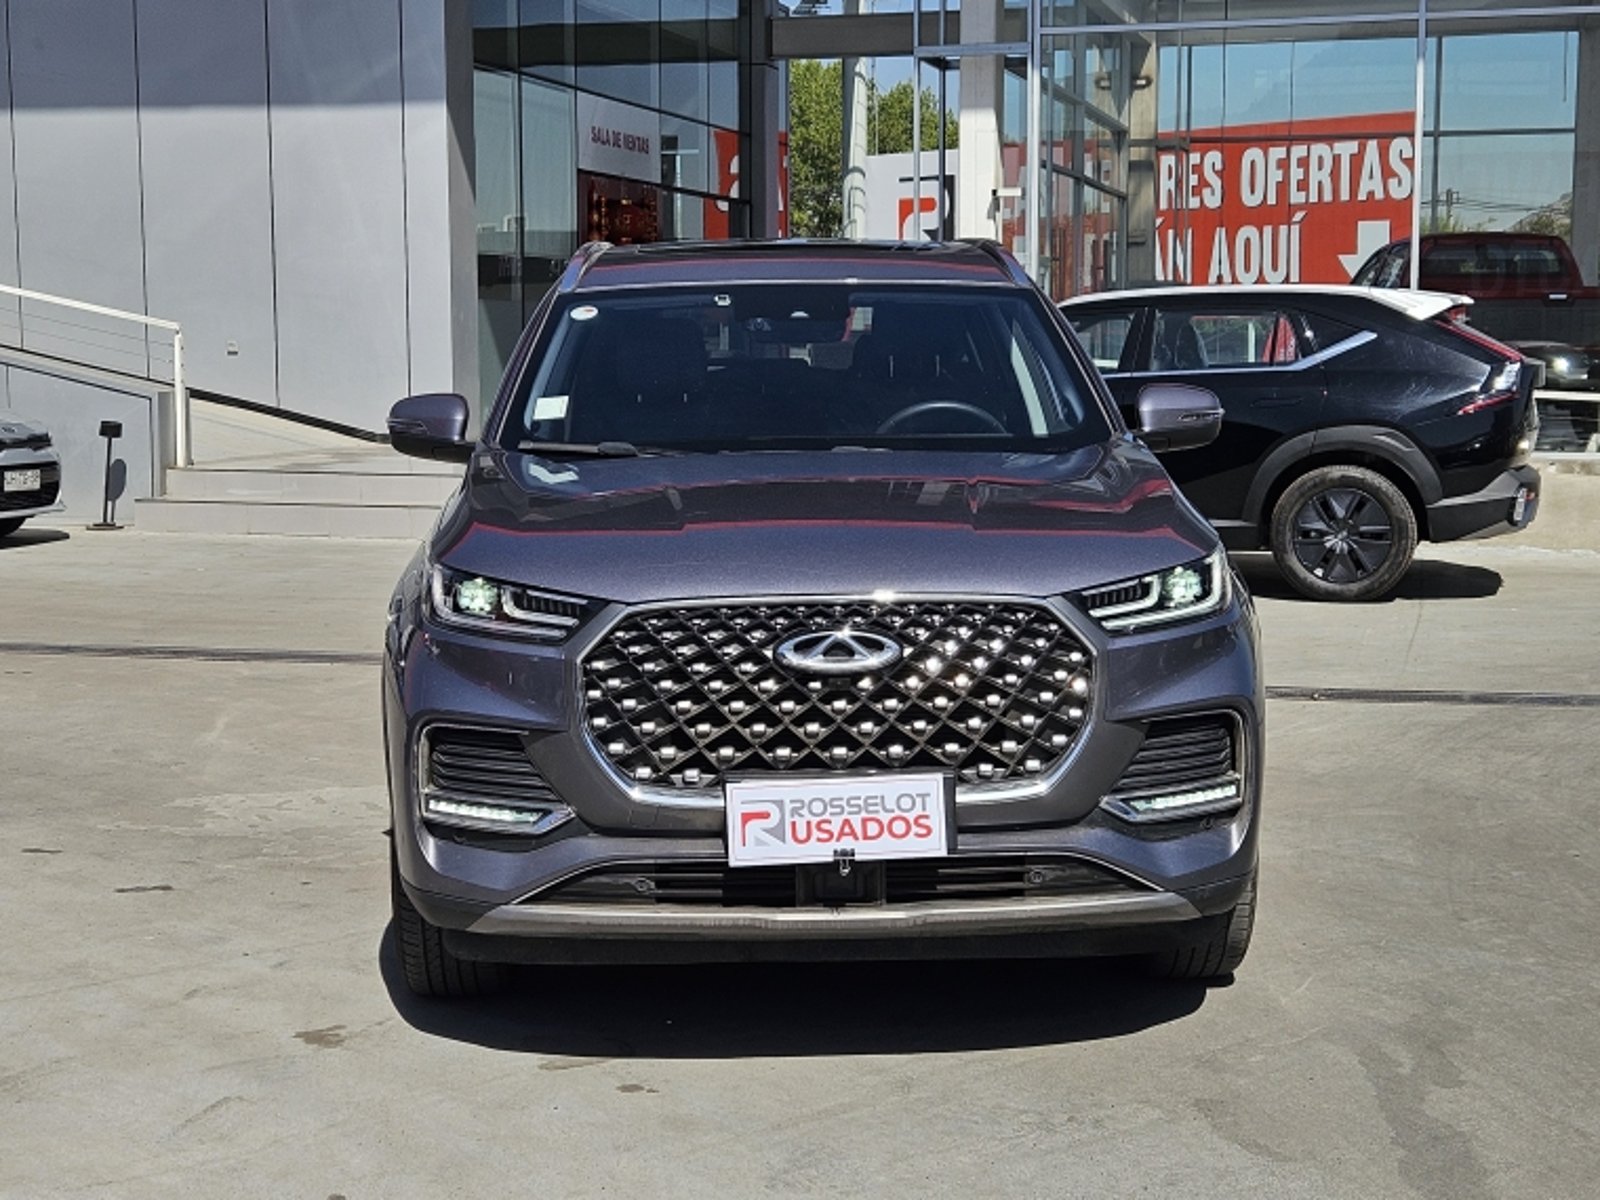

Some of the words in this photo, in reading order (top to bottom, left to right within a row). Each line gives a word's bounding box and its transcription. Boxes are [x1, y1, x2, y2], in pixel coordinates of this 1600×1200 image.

[591, 126, 611, 146] SALA
[612, 130, 621, 148] DE
[1241, 137, 1413, 207] OFERTAS
[1208, 210, 1308, 285] AQUÍ
[789, 793, 931, 818] ROSSELOT
[790, 814, 933, 844] USADOS
